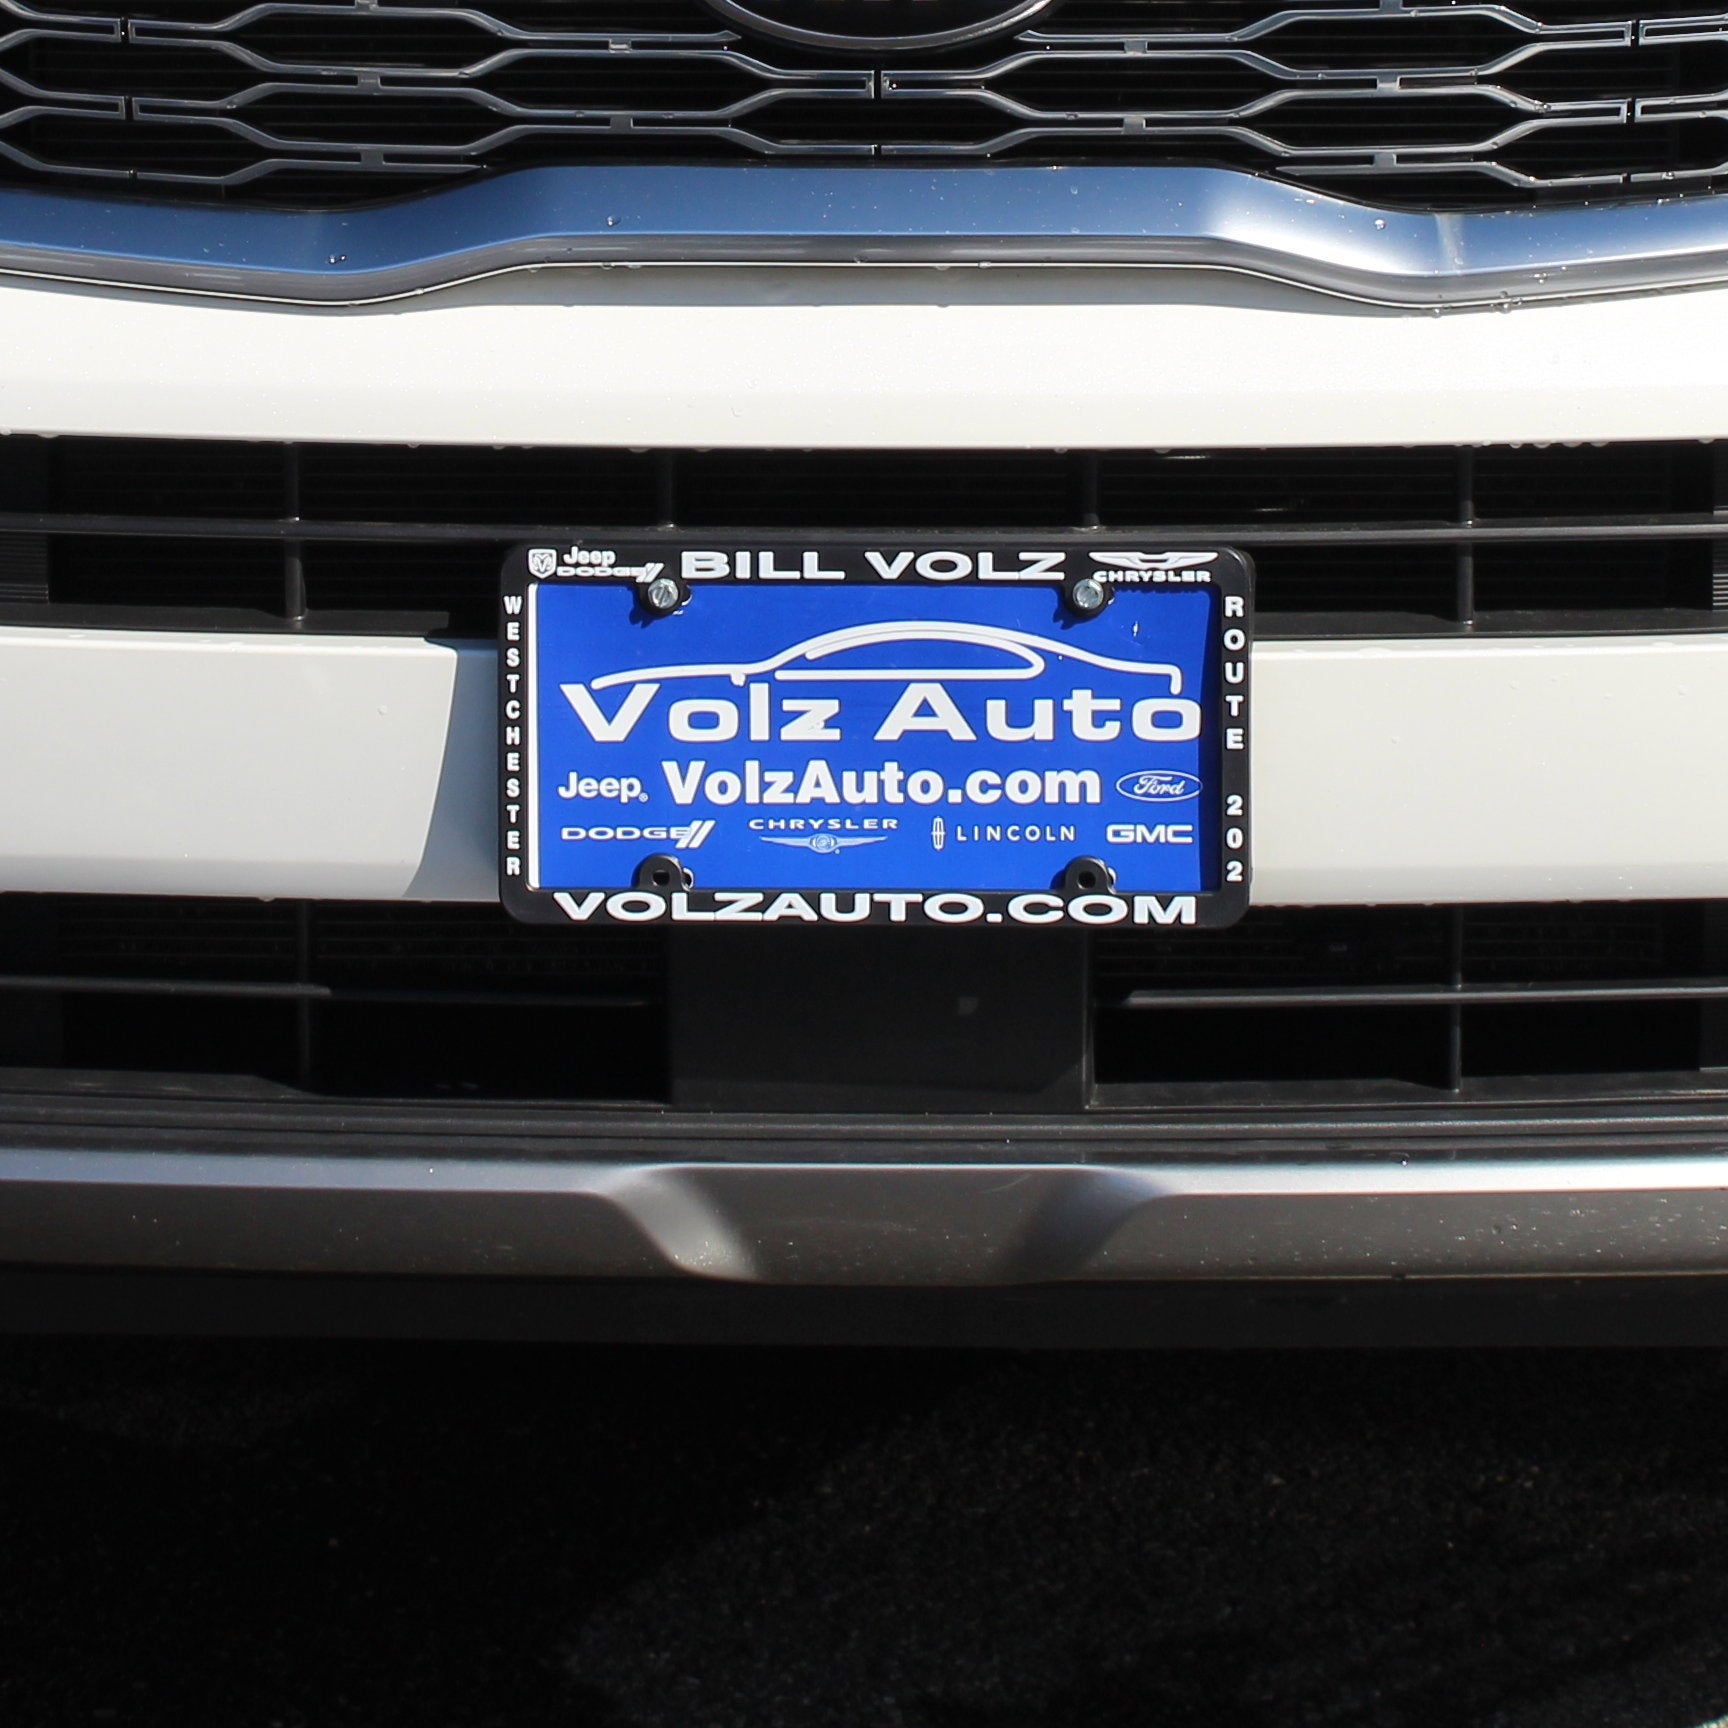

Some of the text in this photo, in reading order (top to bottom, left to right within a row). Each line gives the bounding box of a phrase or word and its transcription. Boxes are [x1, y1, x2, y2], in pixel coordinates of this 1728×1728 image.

[563, 546, 616, 567] Jeep
[681, 551, 1066, 580] BILL VOLZ
[1092, 570, 1212, 583] CHRYSLER
[559, 682, 1202, 742] Volz Auto
[503, 595, 523, 875] WESTCHESTER
[1223, 595, 1246, 882] ROUTE 202
[661, 759, 1103, 805] VolzAuto.com
[1132, 773, 1187, 797] Ford
[560, 826, 690, 841] DODGE
[748, 818, 899, 831] CHRYSLER
[956, 824, 1076, 842] LINCOLN
[1106, 824, 1194, 844] GMC
[553, 890, 1199, 925] VOLZAUTO.COM
